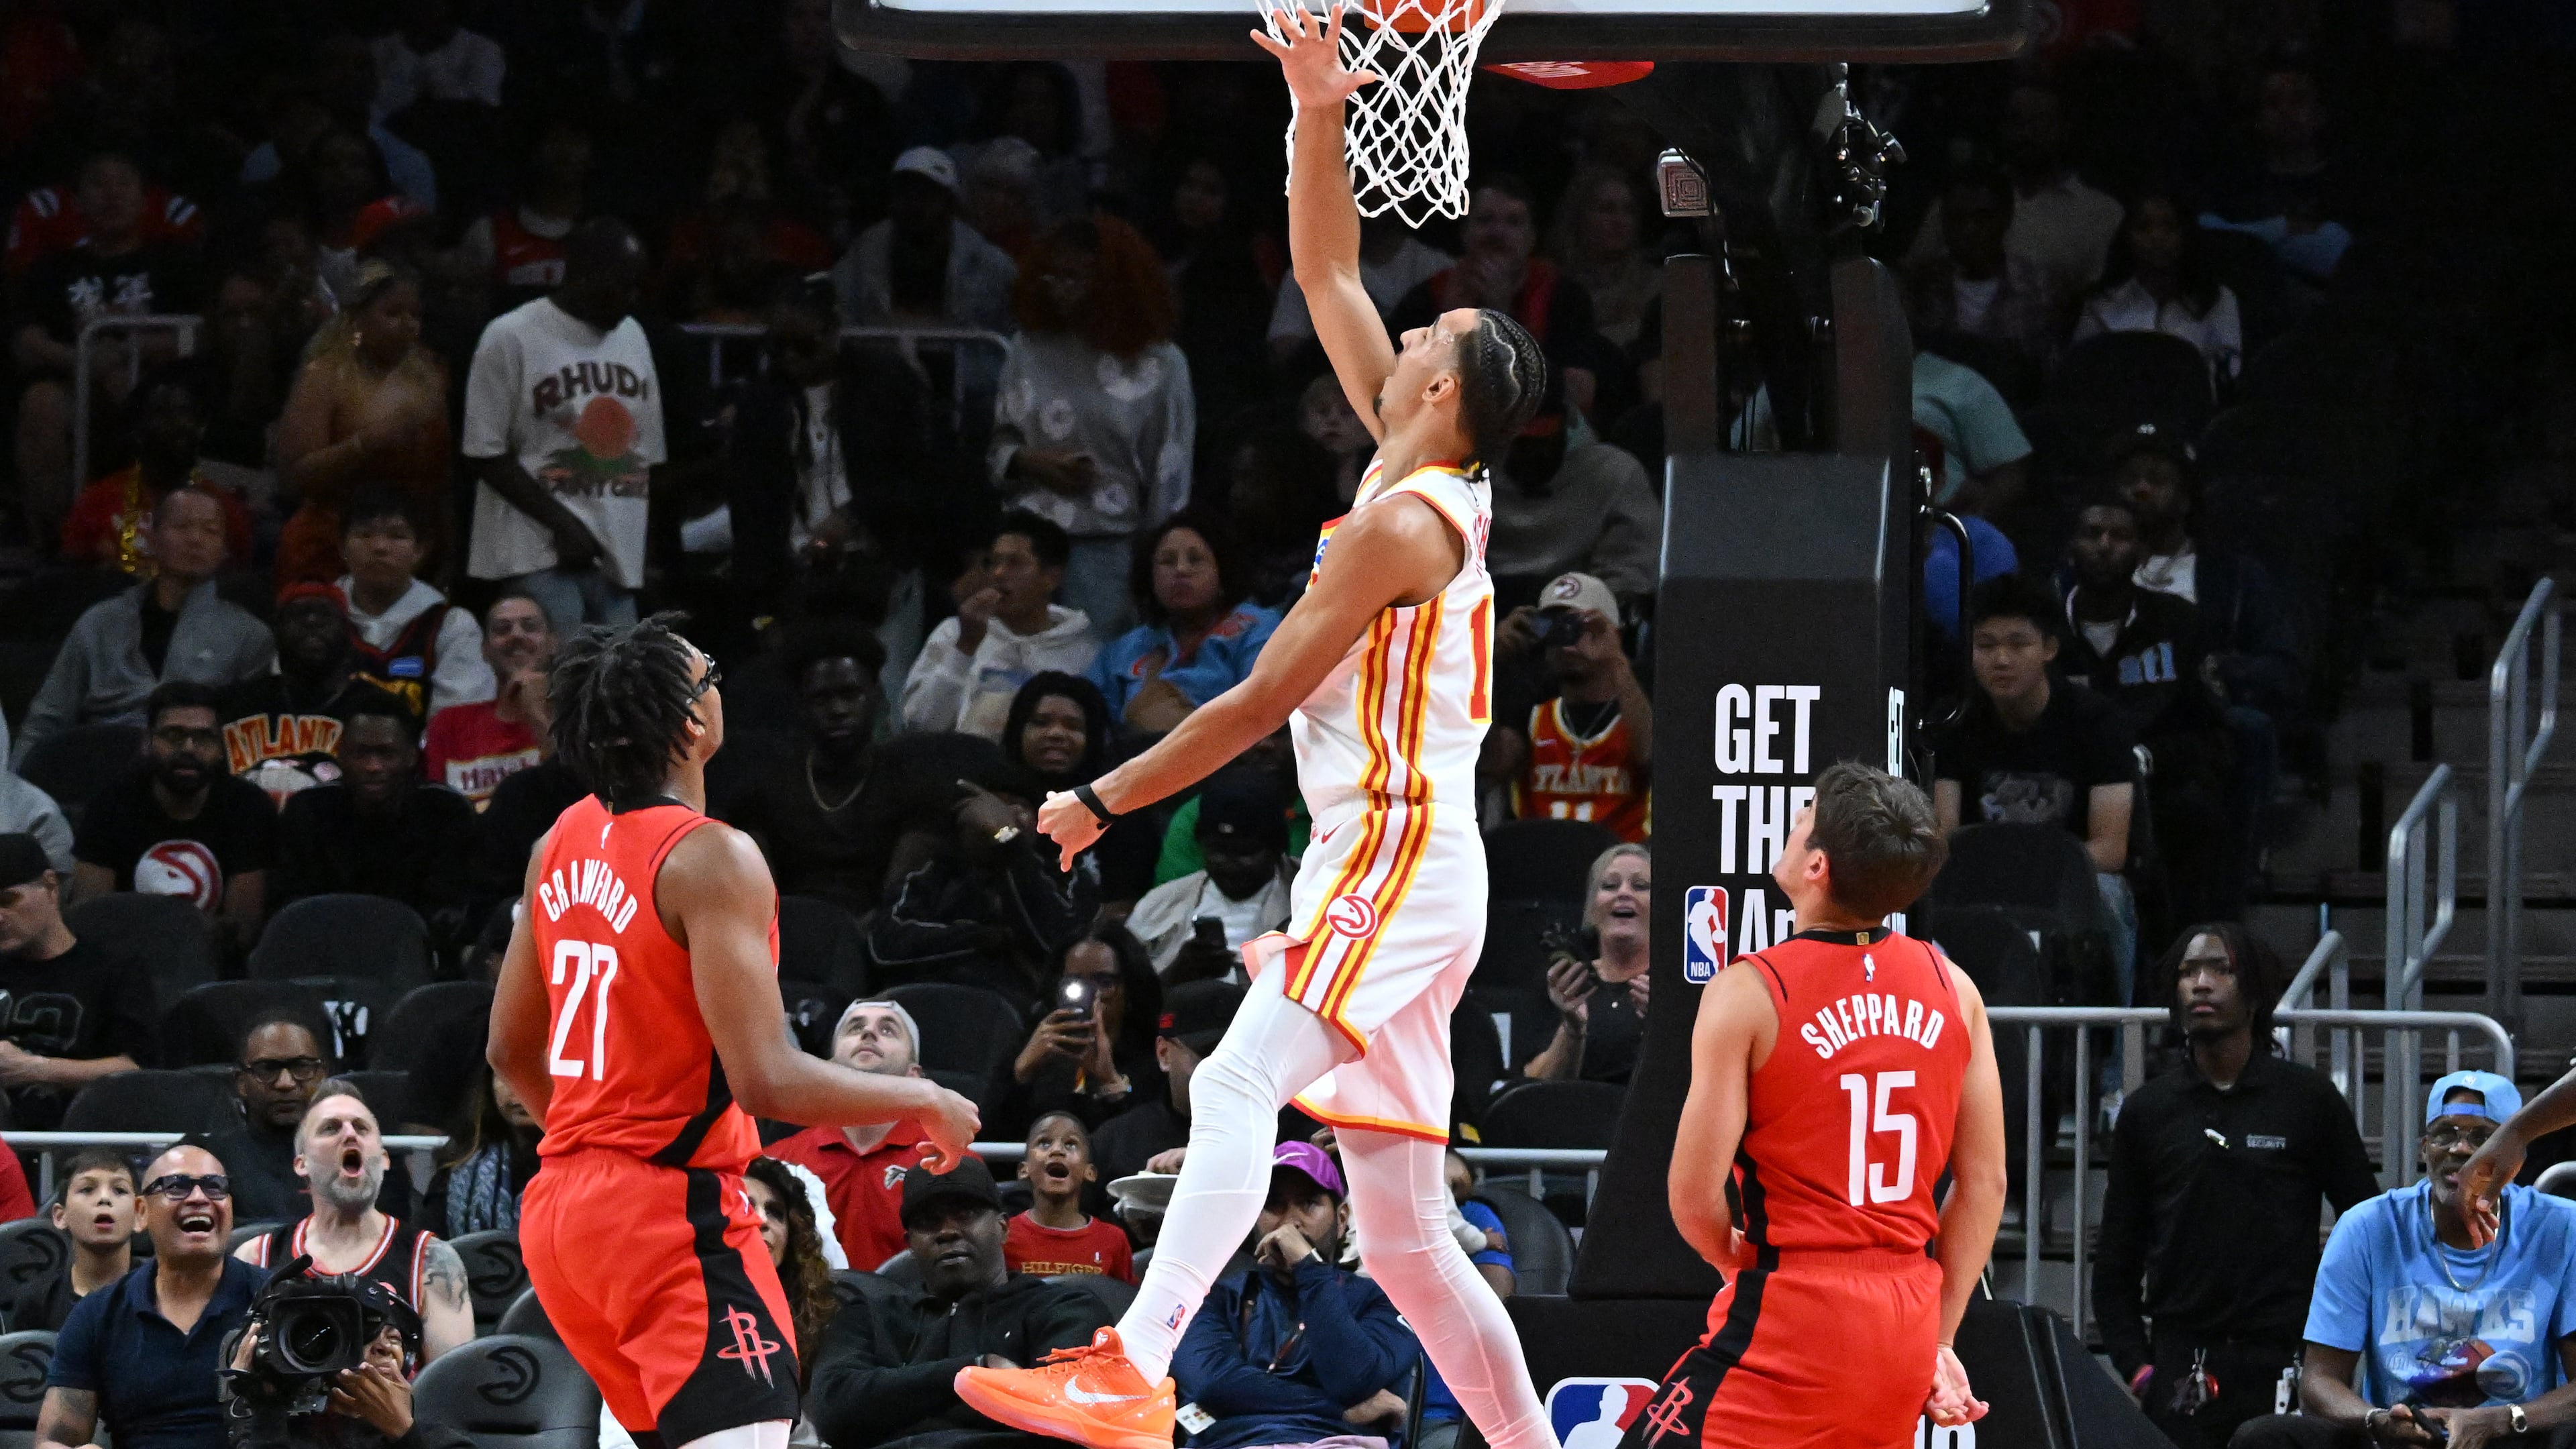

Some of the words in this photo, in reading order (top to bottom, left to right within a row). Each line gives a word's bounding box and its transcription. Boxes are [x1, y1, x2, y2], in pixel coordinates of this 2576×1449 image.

[1715, 684, 1821, 774] GET
[539, 859, 638, 934] CRAWFORD
[1690, 962, 1711, 977] NBA
[549, 939, 619, 1081] 27
[1801, 994, 1944, 1059] SHEPPARD
[1840, 1071, 1917, 1206] 15
[2379, 1286, 2535, 1344] HAWKS
